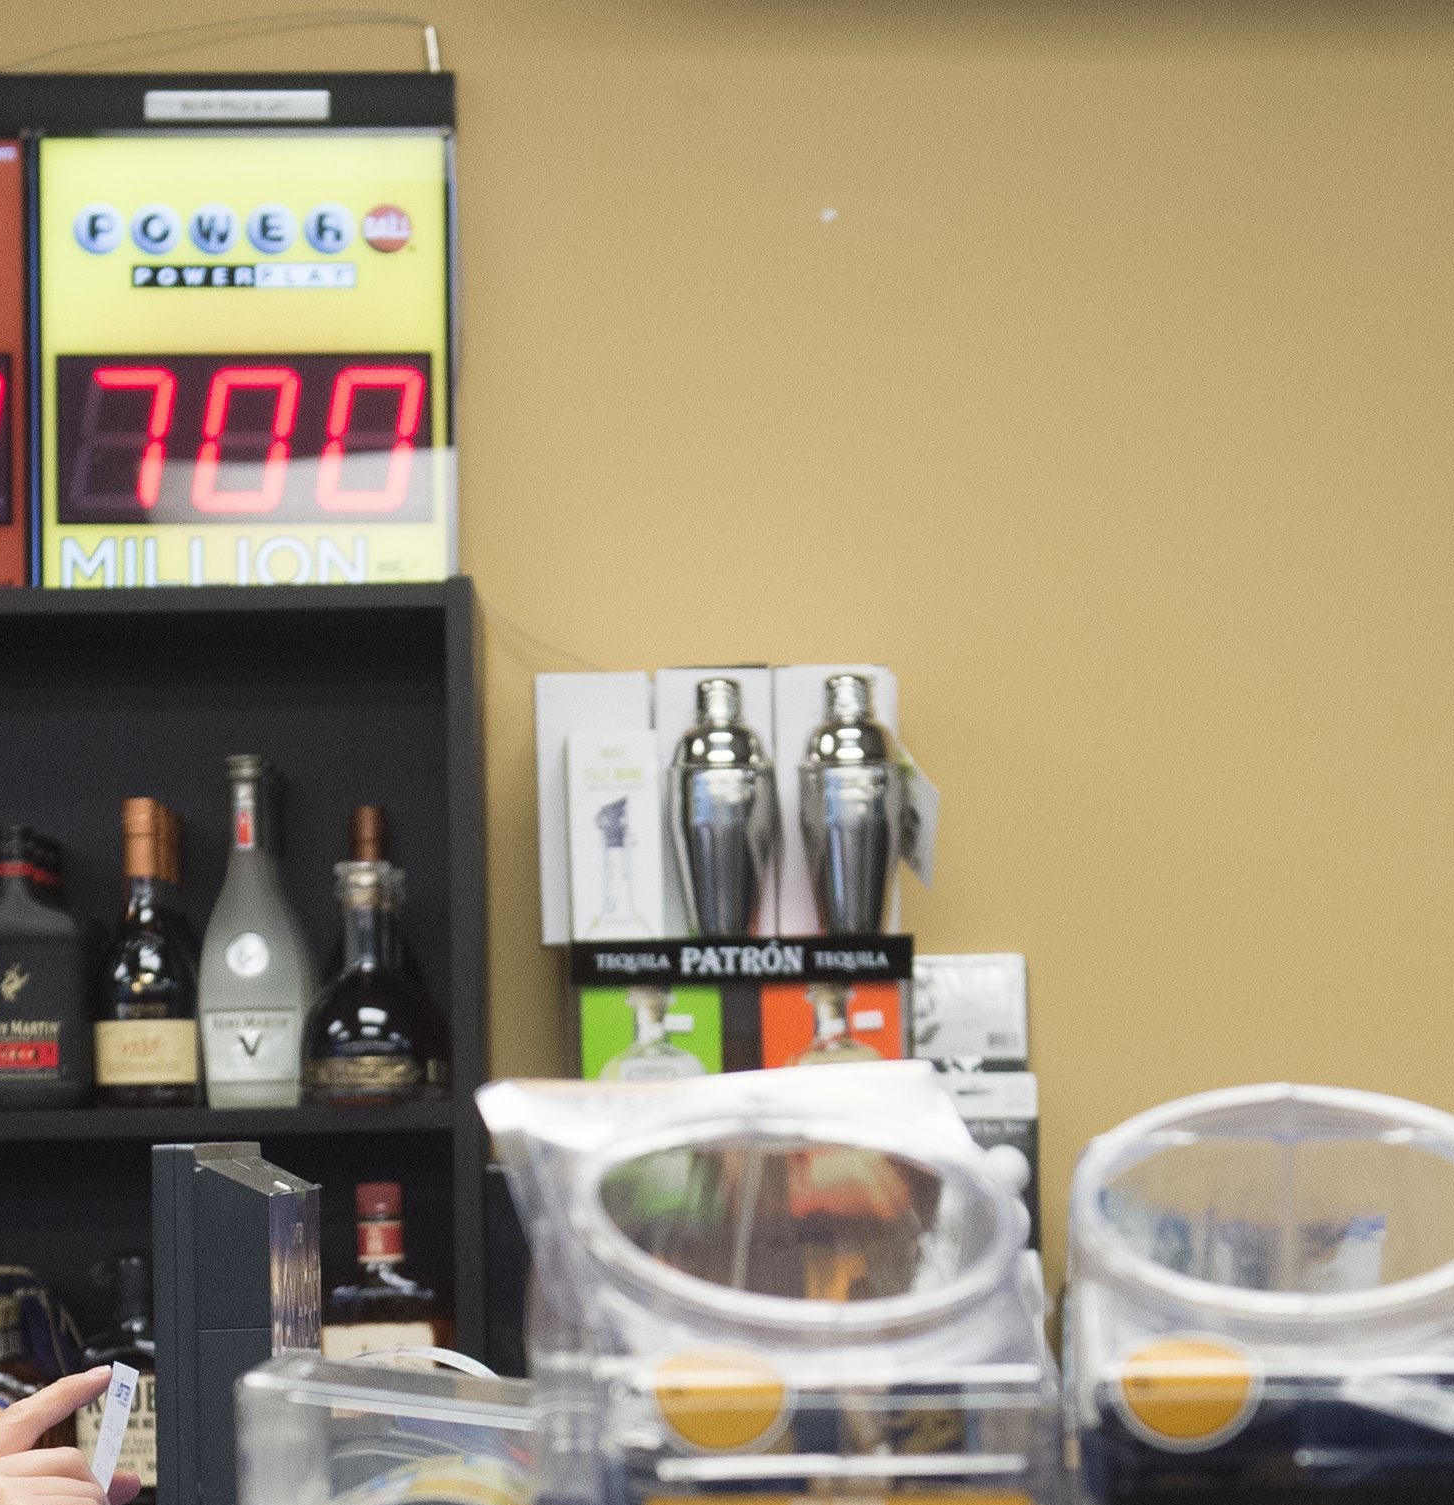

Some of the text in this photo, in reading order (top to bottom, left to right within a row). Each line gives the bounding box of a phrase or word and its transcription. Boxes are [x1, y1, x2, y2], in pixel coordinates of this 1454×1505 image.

[83, 209, 346, 248] POWER
[92, 365, 426, 515] 700
[59, 535, 369, 589] MILLION
[595, 941, 890, 976] TEQUILA PATRÓN TEQUILA
[239, 1032, 262, 1057] V
